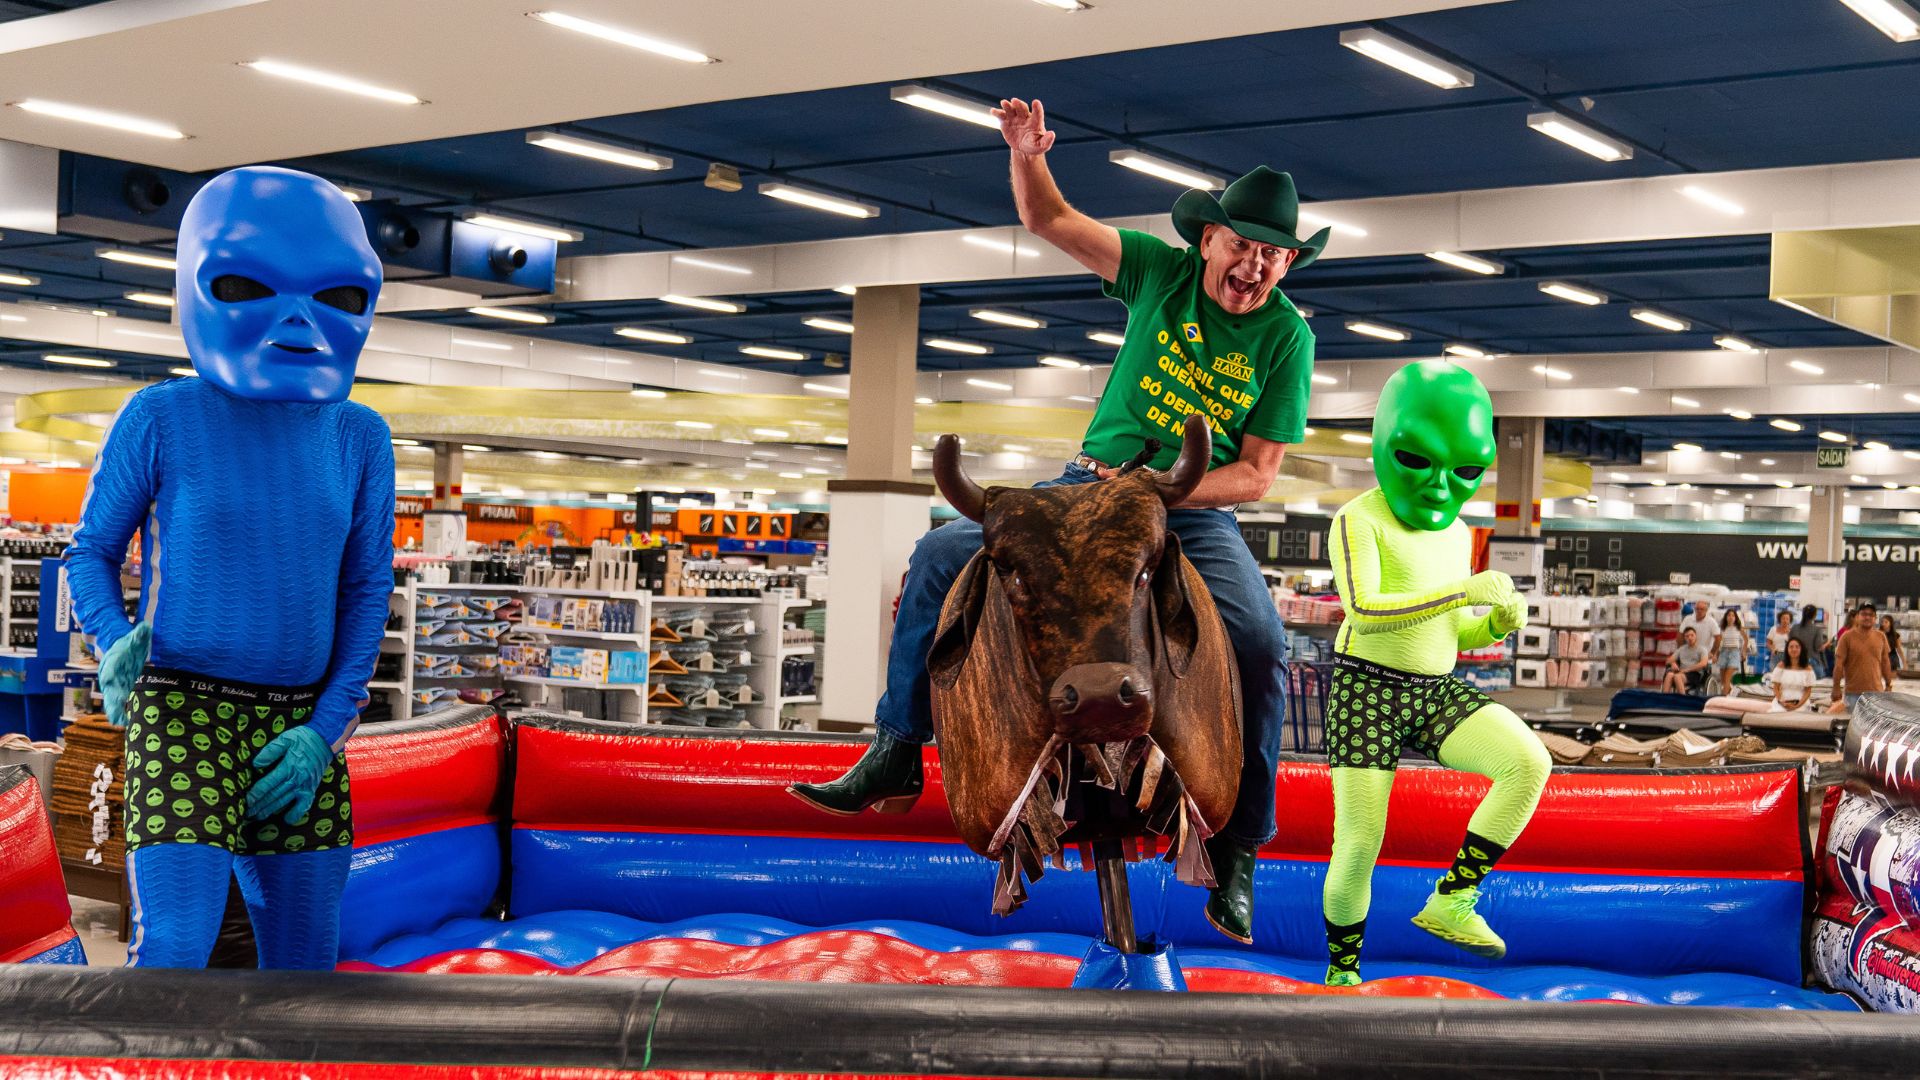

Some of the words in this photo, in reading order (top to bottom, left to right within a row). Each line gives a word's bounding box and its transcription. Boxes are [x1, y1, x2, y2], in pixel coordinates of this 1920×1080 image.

[1157, 330, 1169, 345] O
[1219, 384, 1255, 410] QUE
[1213, 358, 1253, 380] HAVAN
[1139, 375, 1163, 397] SÓ
[1157, 355, 1234, 421] QUERMOS
[1146, 405, 1171, 428] DE
[1818, 449, 1844, 466] SAÍDA
[480, 505, 517, 520] PRAIA
[622, 511, 672, 525] CAING
[1365, 664, 1380, 675] TBK
[190, 680, 216, 692] TBK
[267, 692, 290, 702] TBK
